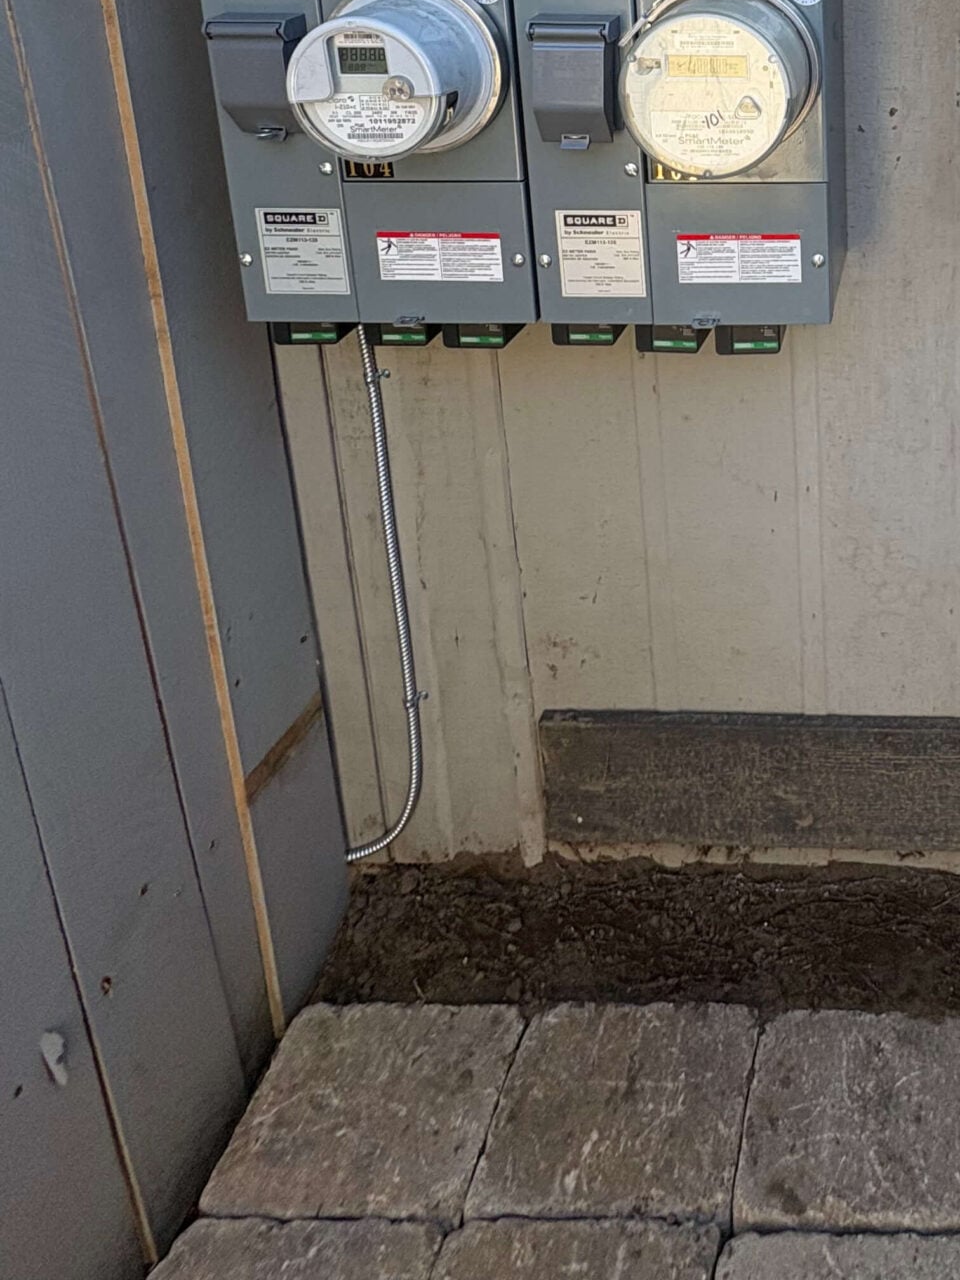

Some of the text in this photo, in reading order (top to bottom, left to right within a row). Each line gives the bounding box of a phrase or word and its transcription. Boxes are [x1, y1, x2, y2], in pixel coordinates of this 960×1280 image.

[704, 110, 725, 130] 101
[678, 136, 744, 145] SmartMeter
[350, 160, 392, 176] 104
[266, 214, 314, 222] SQUARE
